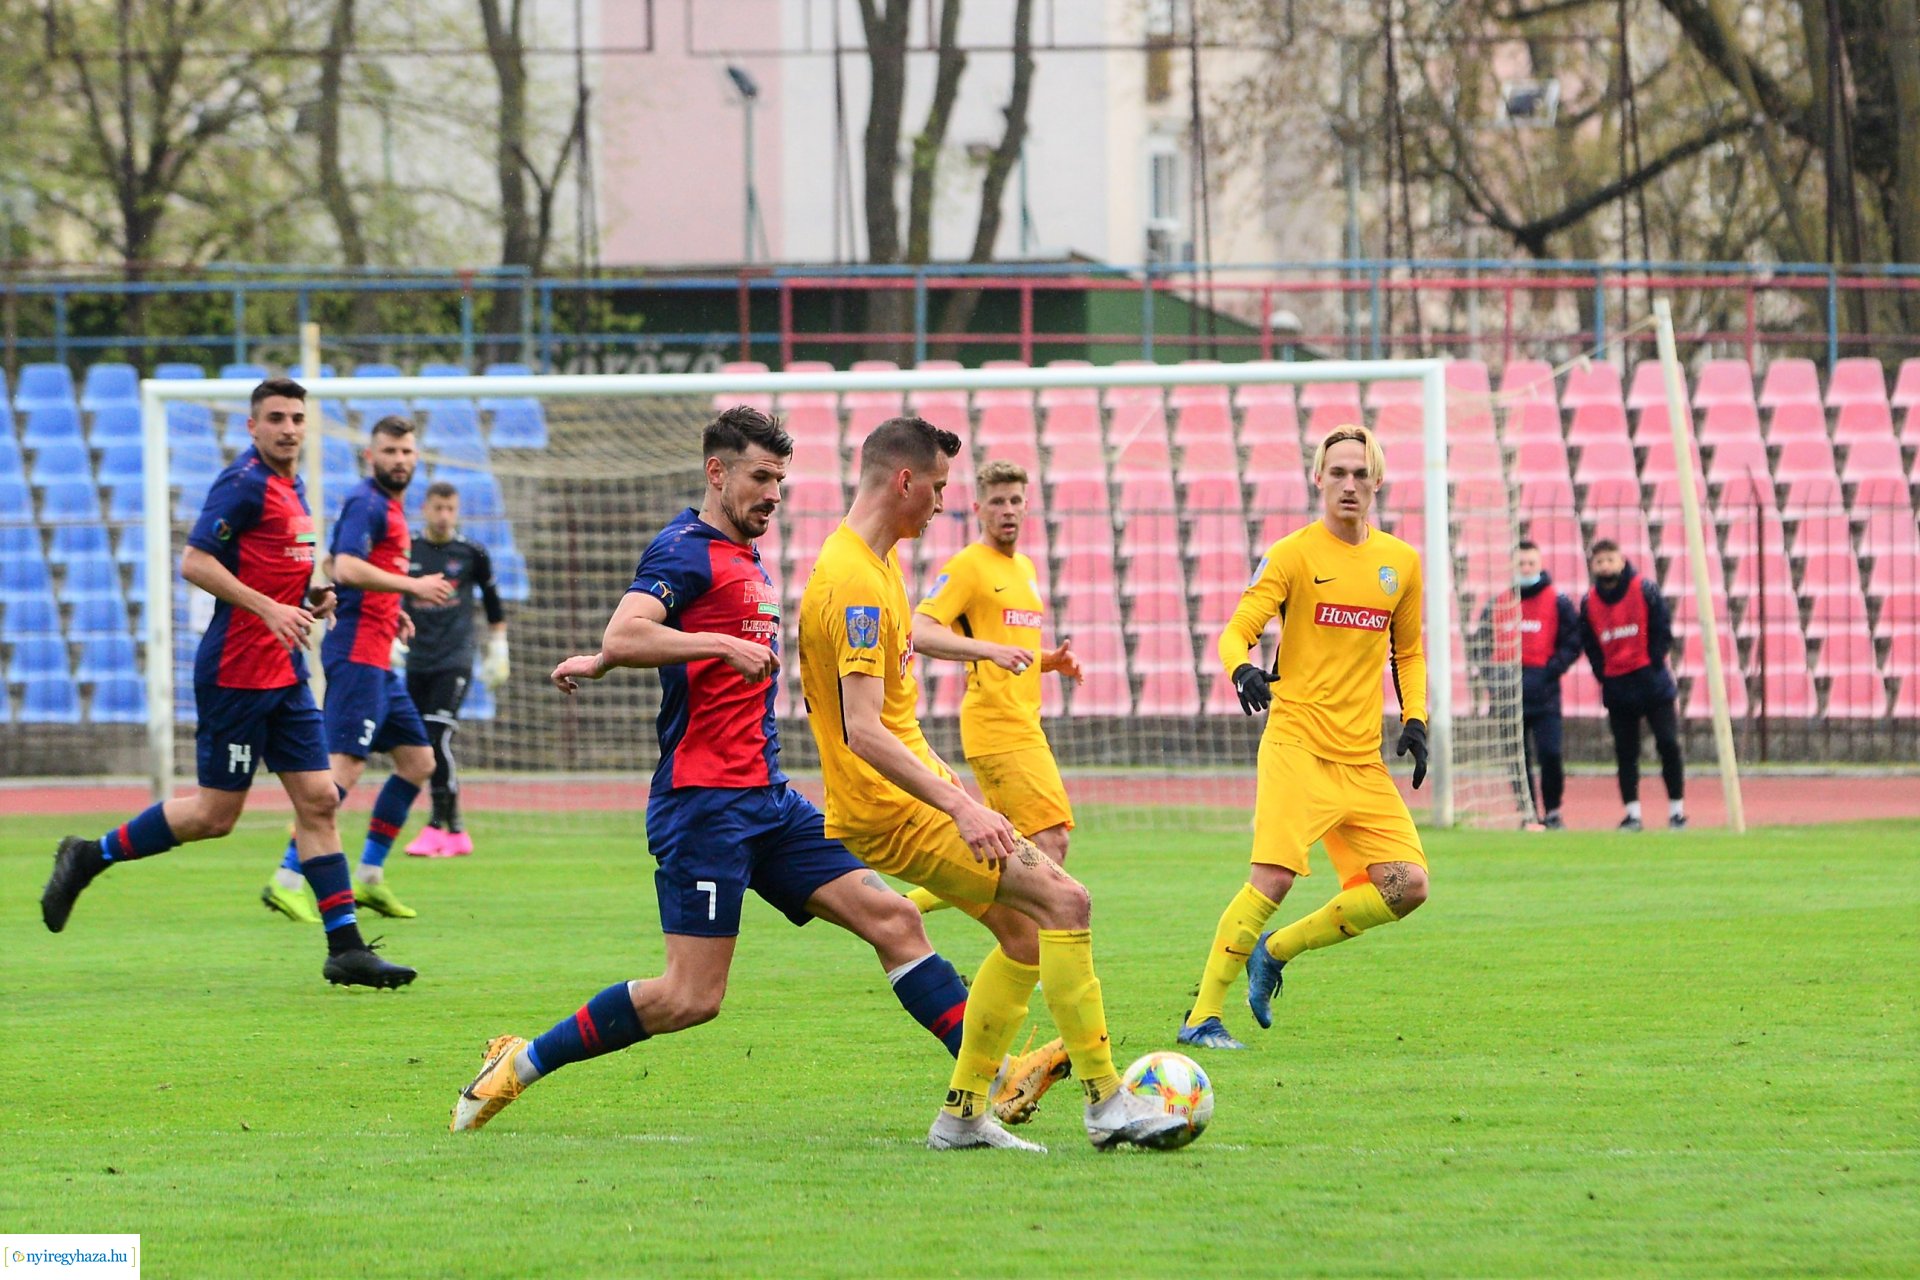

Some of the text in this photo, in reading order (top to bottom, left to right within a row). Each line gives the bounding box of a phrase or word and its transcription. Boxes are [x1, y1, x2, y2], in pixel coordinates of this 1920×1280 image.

[1319, 606, 1388, 629] HUNGAST
[358, 719, 376, 746] 3
[228, 743, 252, 774] 14
[696, 881, 717, 920] 7
